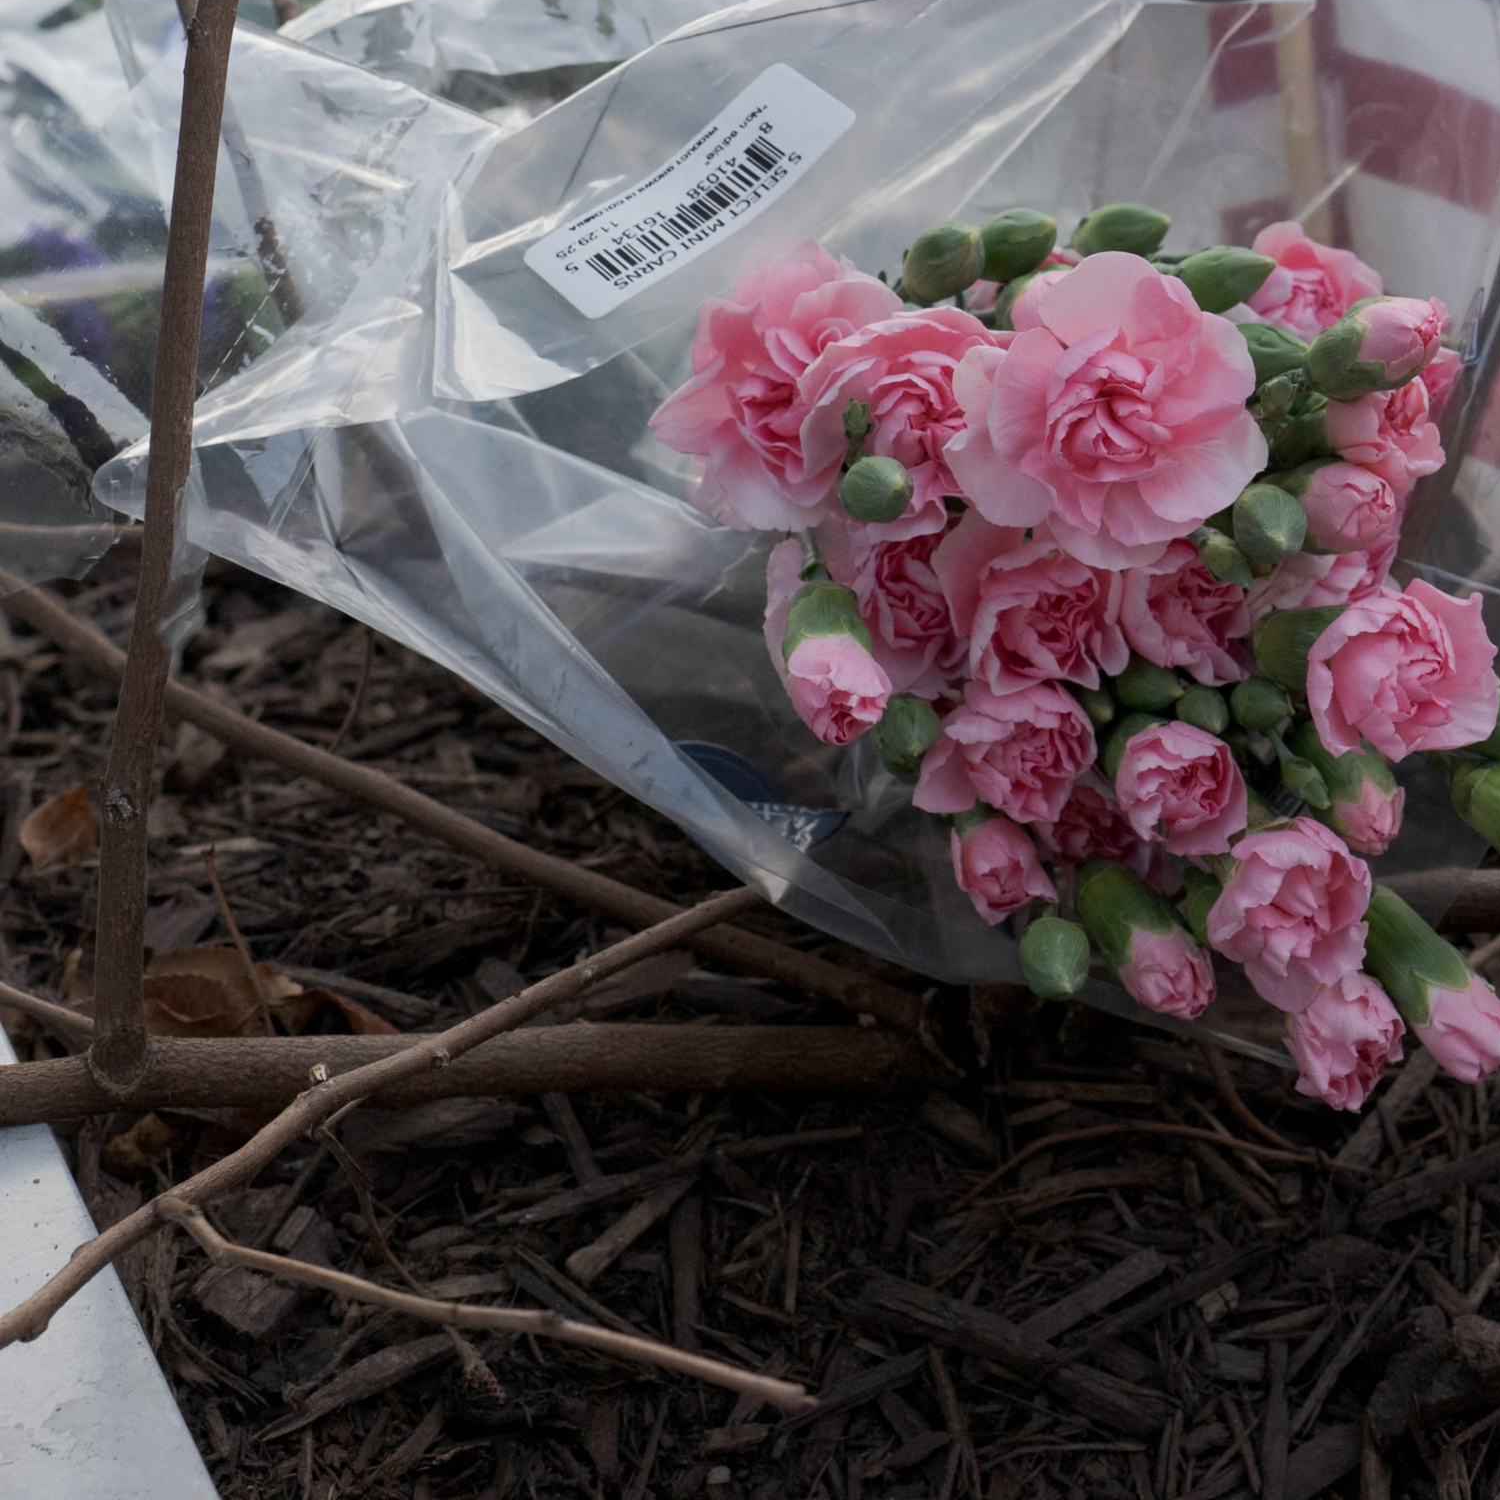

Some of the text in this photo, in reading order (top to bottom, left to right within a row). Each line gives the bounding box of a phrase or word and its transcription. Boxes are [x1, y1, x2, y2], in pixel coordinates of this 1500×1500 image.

[564, 121, 773, 275] 8 41038 16134 5
[568, 126, 719, 231] PRODUCT GROWN IN COLOMBIA
[728, 165, 788, 220] SELECT
[556, 220, 620, 260] 11.29.25
[679, 218, 725, 251] MINI
[613, 249, 678, 290] CARNS
